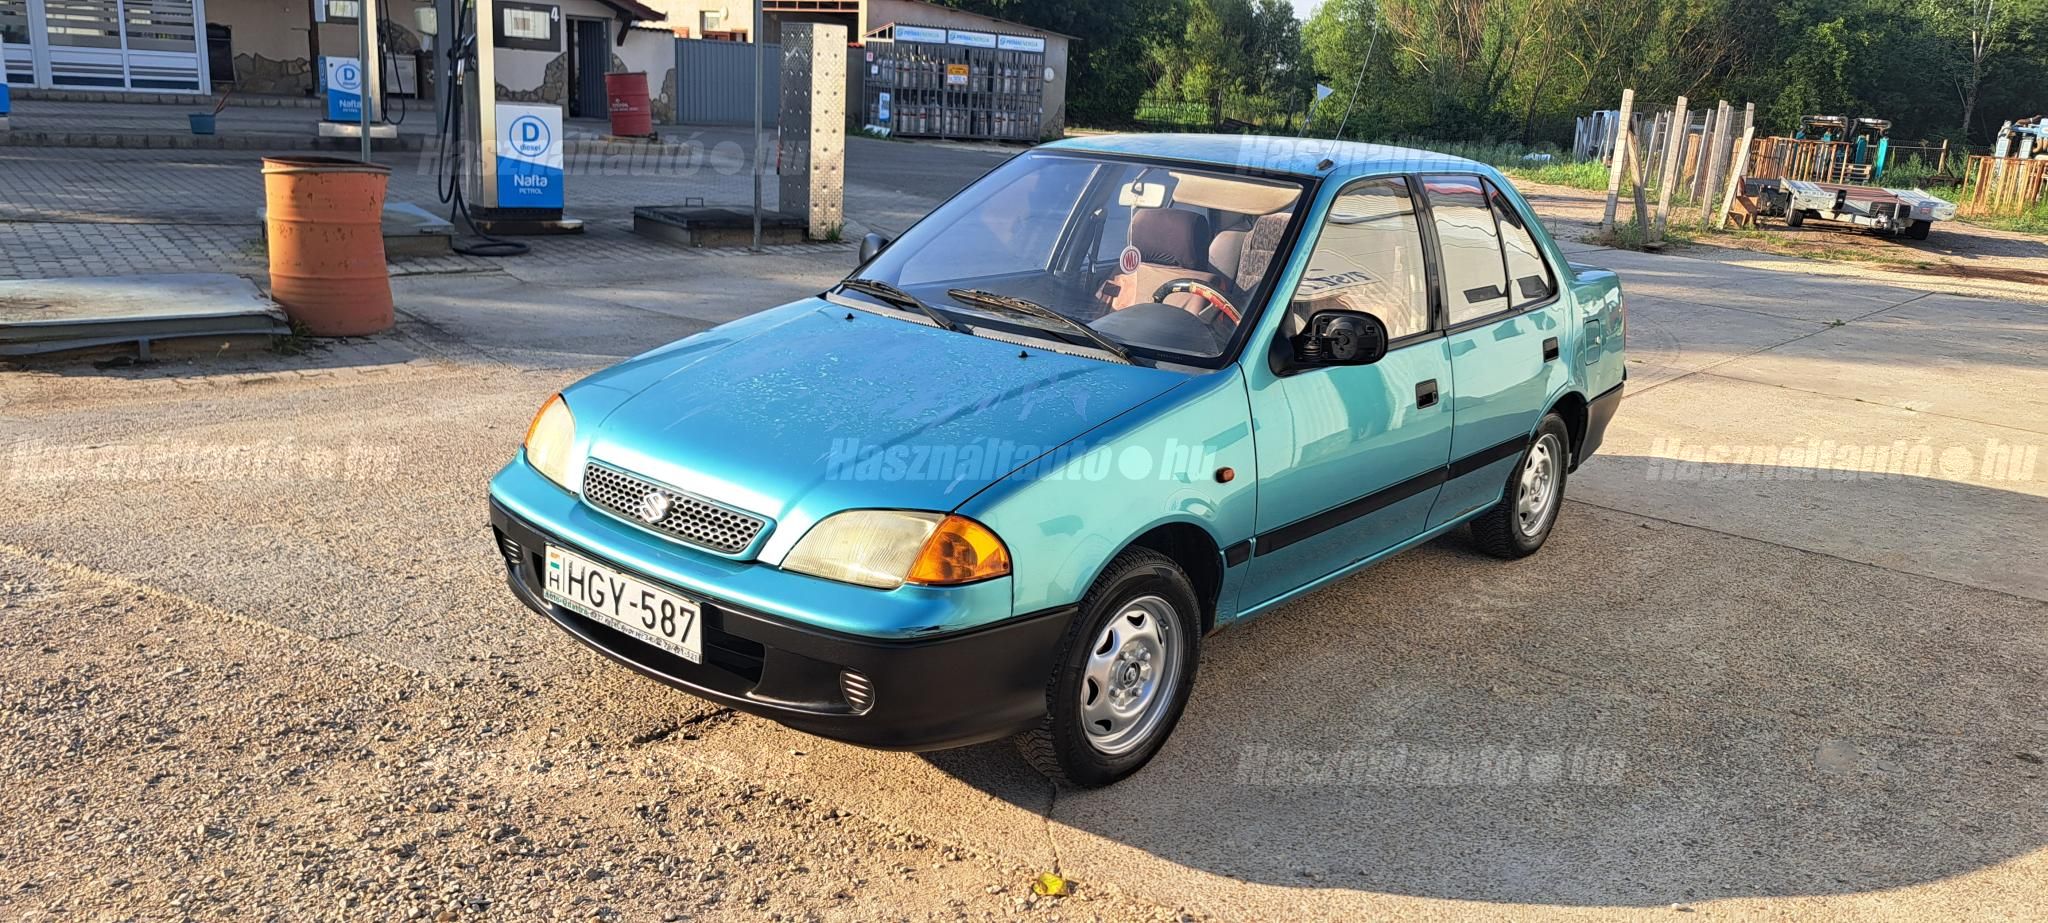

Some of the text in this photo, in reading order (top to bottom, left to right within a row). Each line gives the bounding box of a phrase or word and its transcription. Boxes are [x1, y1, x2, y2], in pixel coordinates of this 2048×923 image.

[551, 7, 559, 22] 4
[344, 68, 355, 81] D
[522, 122, 540, 142] D
[514, 174, 548, 187] Nafta
[549, 571, 560, 591] H
[568, 560, 696, 643] HGY-587
